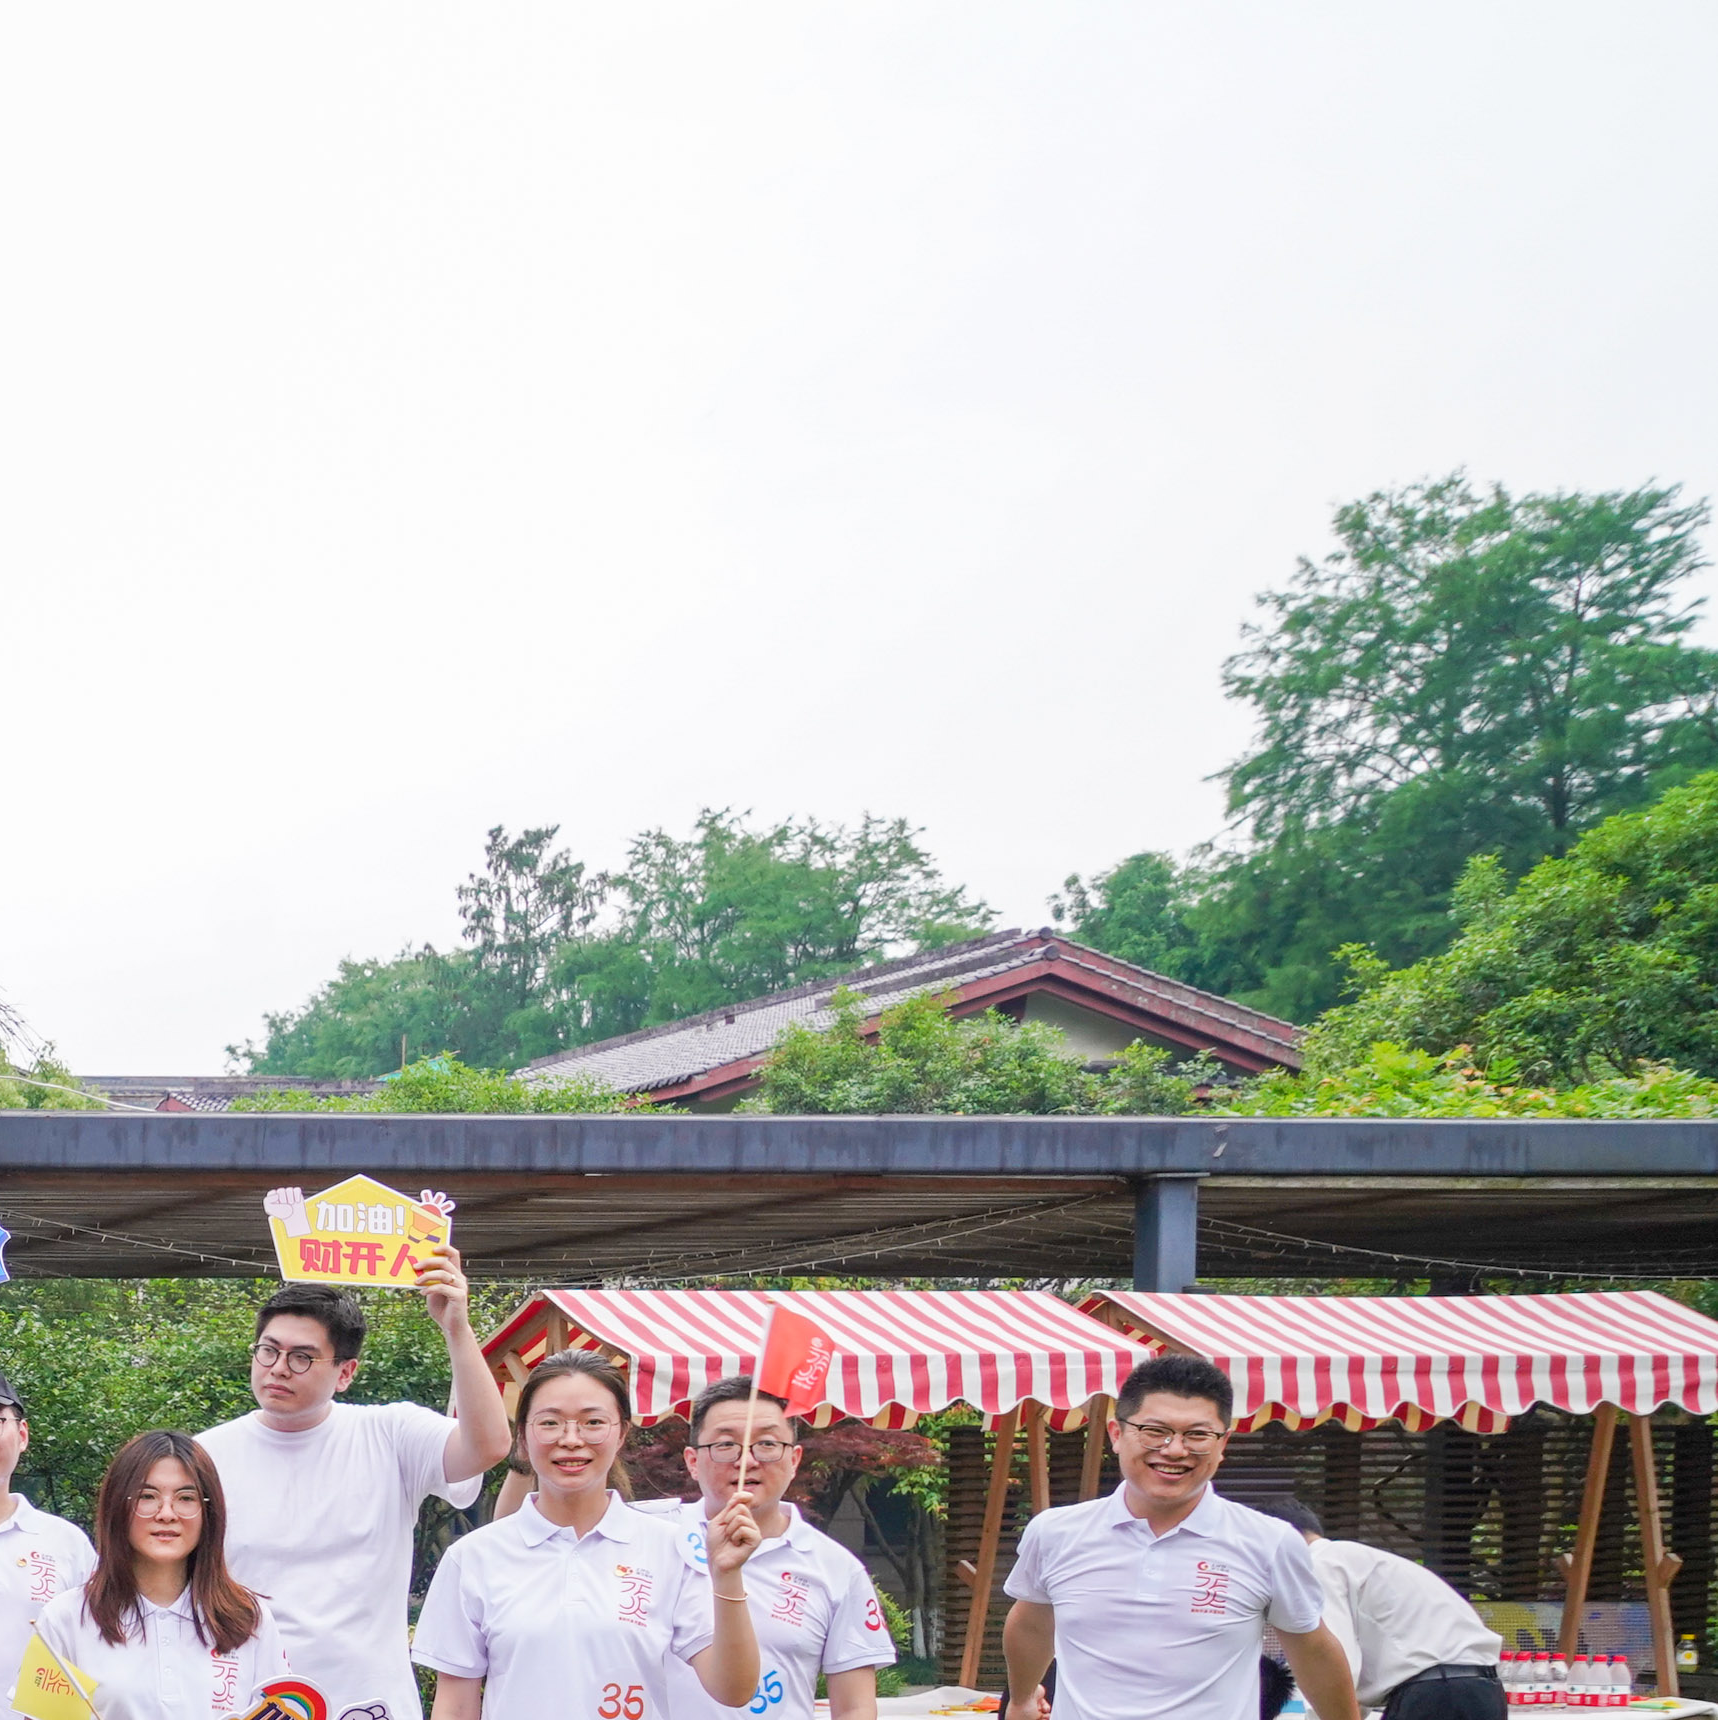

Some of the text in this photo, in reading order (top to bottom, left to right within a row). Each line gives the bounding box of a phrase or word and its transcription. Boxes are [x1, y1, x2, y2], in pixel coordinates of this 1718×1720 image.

[315, 1200, 406, 1236] 加油!
[299, 1238, 426, 1277] 财开人
[687, 1533, 708, 1564] 3
[597, 1683, 645, 1720] 35
